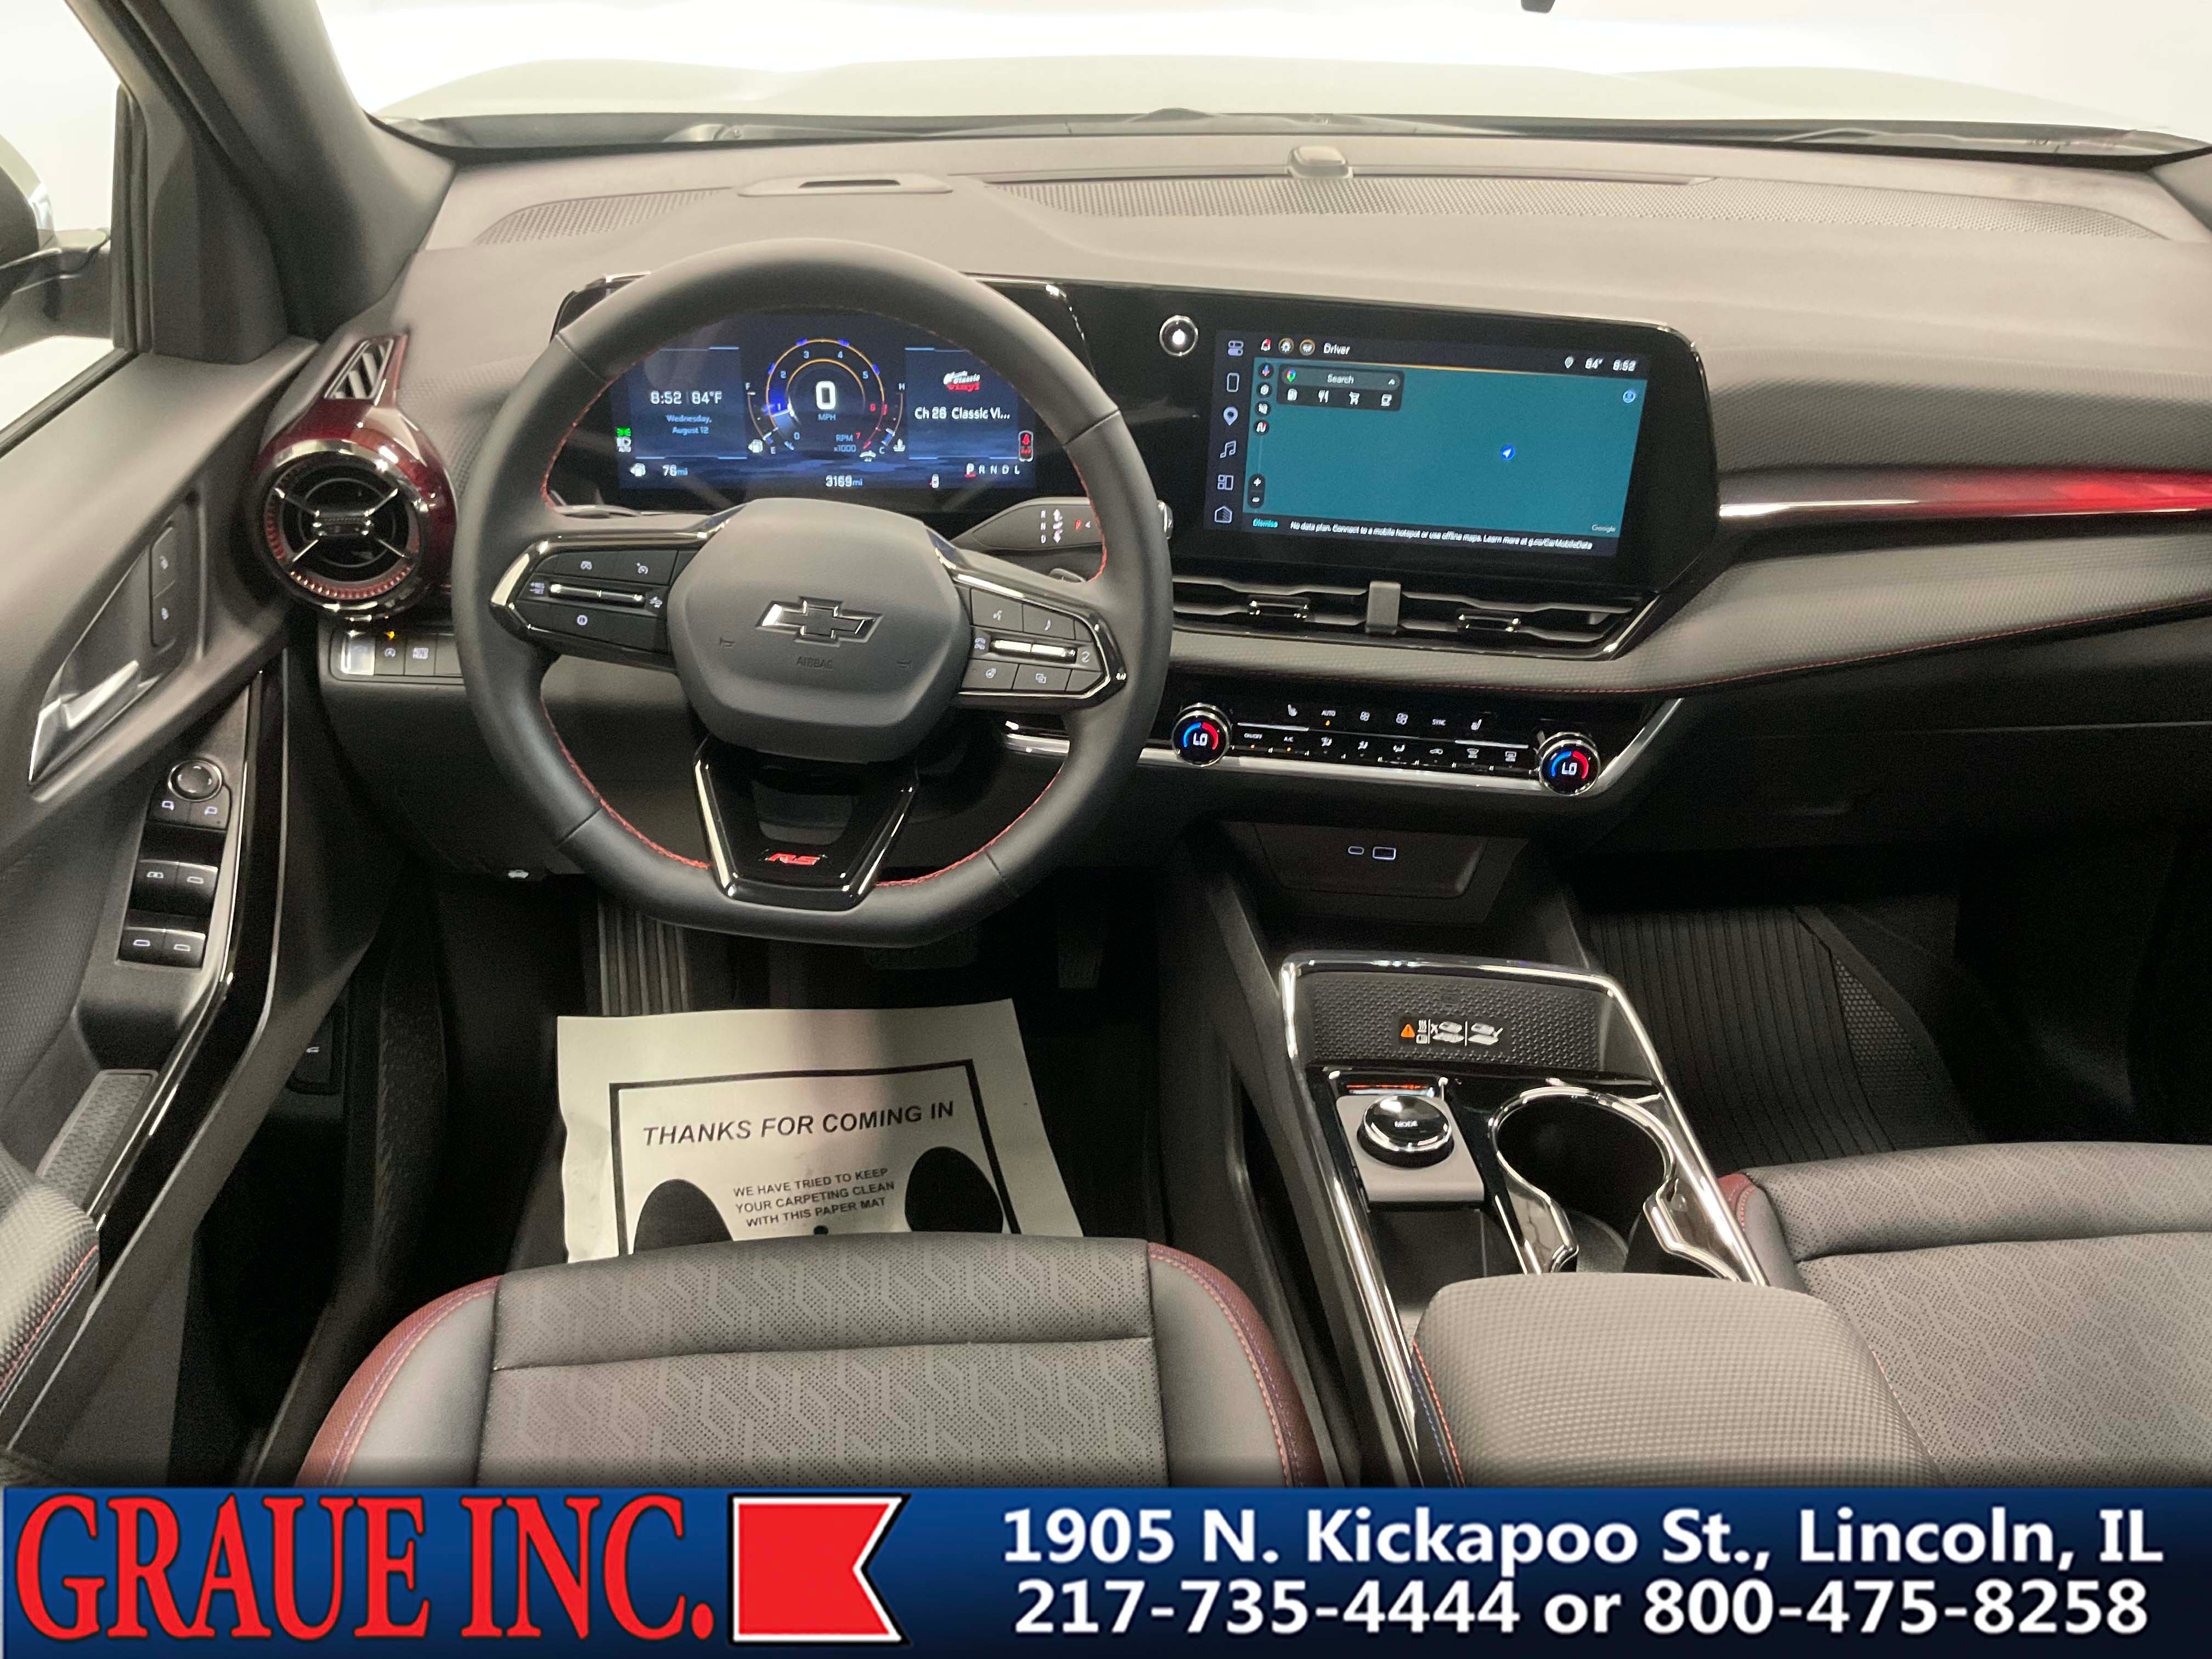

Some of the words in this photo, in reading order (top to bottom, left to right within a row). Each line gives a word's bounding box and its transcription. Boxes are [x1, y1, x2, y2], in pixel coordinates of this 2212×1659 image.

[803, 351, 810, 359] 3
[1323, 343, 1350, 355] Driver
[781, 371, 786, 379] 2
[862, 371, 868, 379] 5
[1327, 374, 1354, 384] Search
[651, 391, 682, 404] 8:52
[691, 391, 723, 404] 84°F
[816, 381, 836, 410] 0
[915, 407, 929, 419] Ch
[951, 407, 988, 419] Classic
[667, 415, 712, 424] Wednesday,
[673, 426, 698, 436] August
[967, 463, 974, 475] P
[979, 465, 985, 474] R
[990, 465, 997, 474] N
[1002, 465, 1009, 474] D
[1015, 466, 1020, 474] L
[1290, 521, 1300, 530] No
[1301, 522, 1315, 531] data
[1373, 527, 1395, 537] mobile
[1483, 534, 1502, 544] Learn
[1503, 536, 1520, 545] more
[1592, 524, 1616, 533] Google
[1193, 733, 1207, 746] LO
[1561, 762, 1577, 775] LO
[766, 853, 821, 865] RS
[643, 1120, 752, 1146] THANKS
[761, 1115, 813, 1137] FOR
[822, 1105, 922, 1133] COMING
[931, 1101, 953, 1119] IN
[733, 1187, 754, 1197] WE
[758, 1182, 791, 1194] HAVE
[794, 1177, 832, 1189] TRIED
[835, 1173, 851, 1183] TO
[855, 1168, 888, 1180] KEEP
[735, 1200, 772, 1214] YOUR
[776, 1188, 849, 1207] CARPETING
[853, 1181, 895, 1195] CLEAN
[746, 1215, 779, 1227] WITH
[783, 1209, 811, 1221] THIS
[816, 1202, 857, 1216] PAPER
[860, 1197, 886, 1209] MAT
